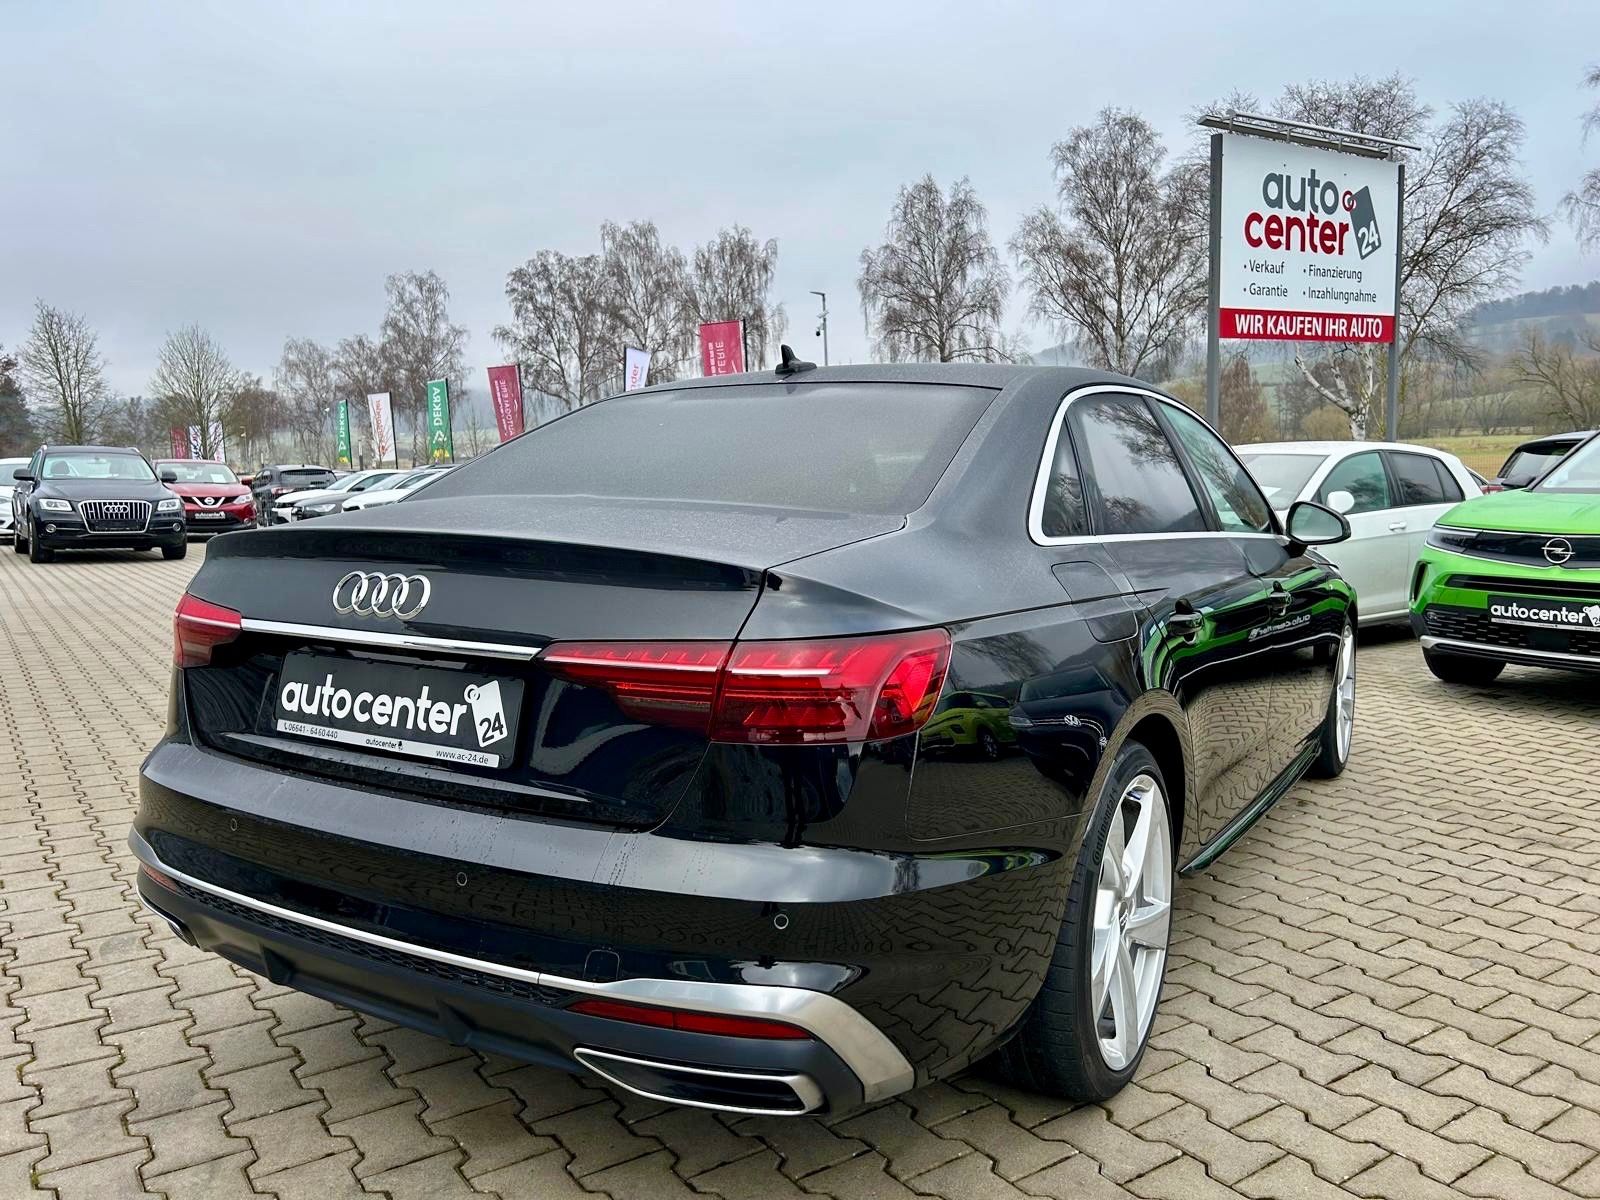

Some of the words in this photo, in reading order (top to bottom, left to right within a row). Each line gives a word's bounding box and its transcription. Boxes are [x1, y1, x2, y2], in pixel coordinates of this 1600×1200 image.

[1262, 169, 1339, 215] auto
[1244, 212, 1350, 256] center
[1357, 220, 1379, 256] 24
[1249, 260, 1285, 275] Verkauf
[1308, 264, 1362, 283] Finanzierung
[1249, 283, 1288, 298] Garantie
[1308, 287, 1377, 304] Inzahlungnahme
[1235, 314, 1264, 335] WIR
[1267, 315, 1322, 337] KAUFEN
[1325, 318, 1347, 337] IHR
[1350, 318, 1383, 338] AUTO
[1490, 602, 1586, 624] autocenter
[281, 673, 467, 736] autocenter
[479, 711, 504, 741] 24
[365, 738, 397, 749] autocenter
[435, 749, 489, 765] www.ac-24.de
